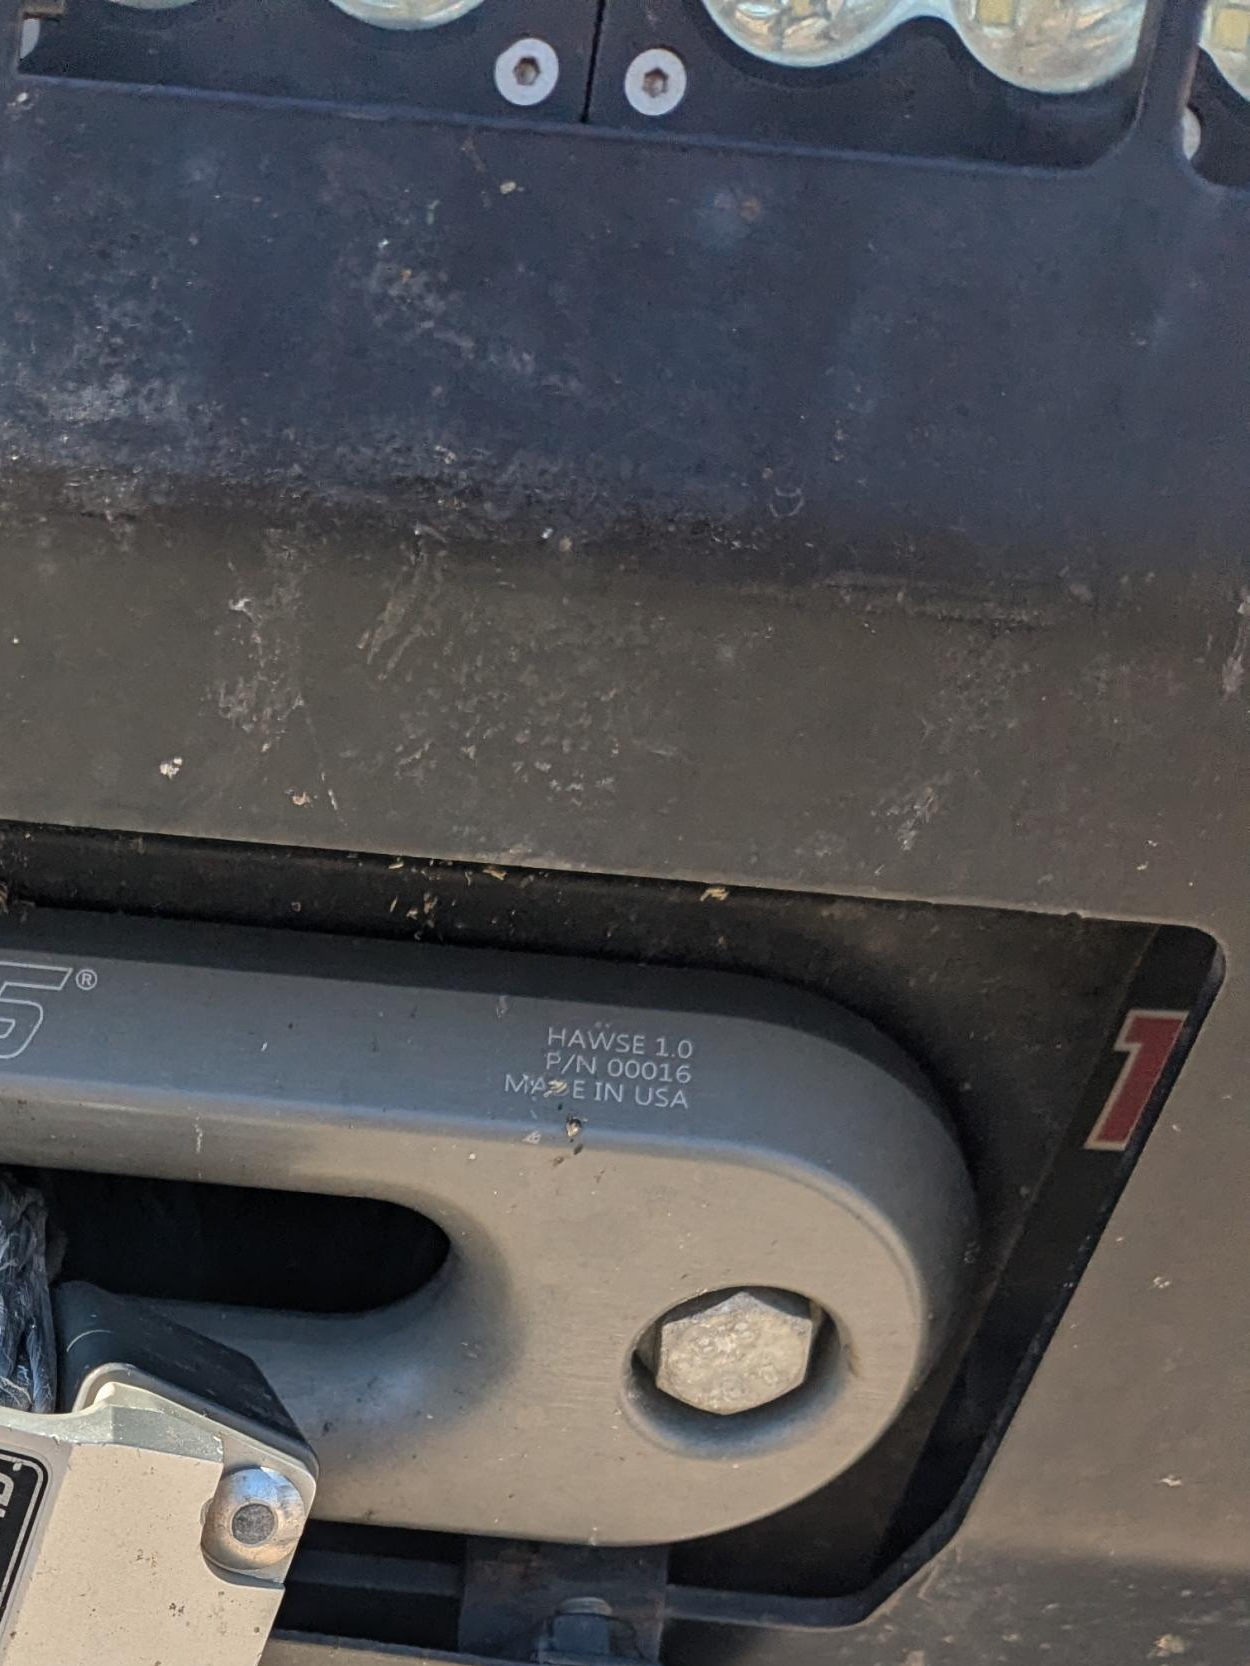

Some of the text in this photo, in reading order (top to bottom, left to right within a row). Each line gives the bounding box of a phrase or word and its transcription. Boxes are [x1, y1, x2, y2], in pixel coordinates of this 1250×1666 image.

[547, 1027, 694, 1059] HAWSE 1.0
[545, 1052, 692, 1084] P/N 00016
[594, 1081, 624, 1103] IN
[634, 1086, 689, 1109] USA
